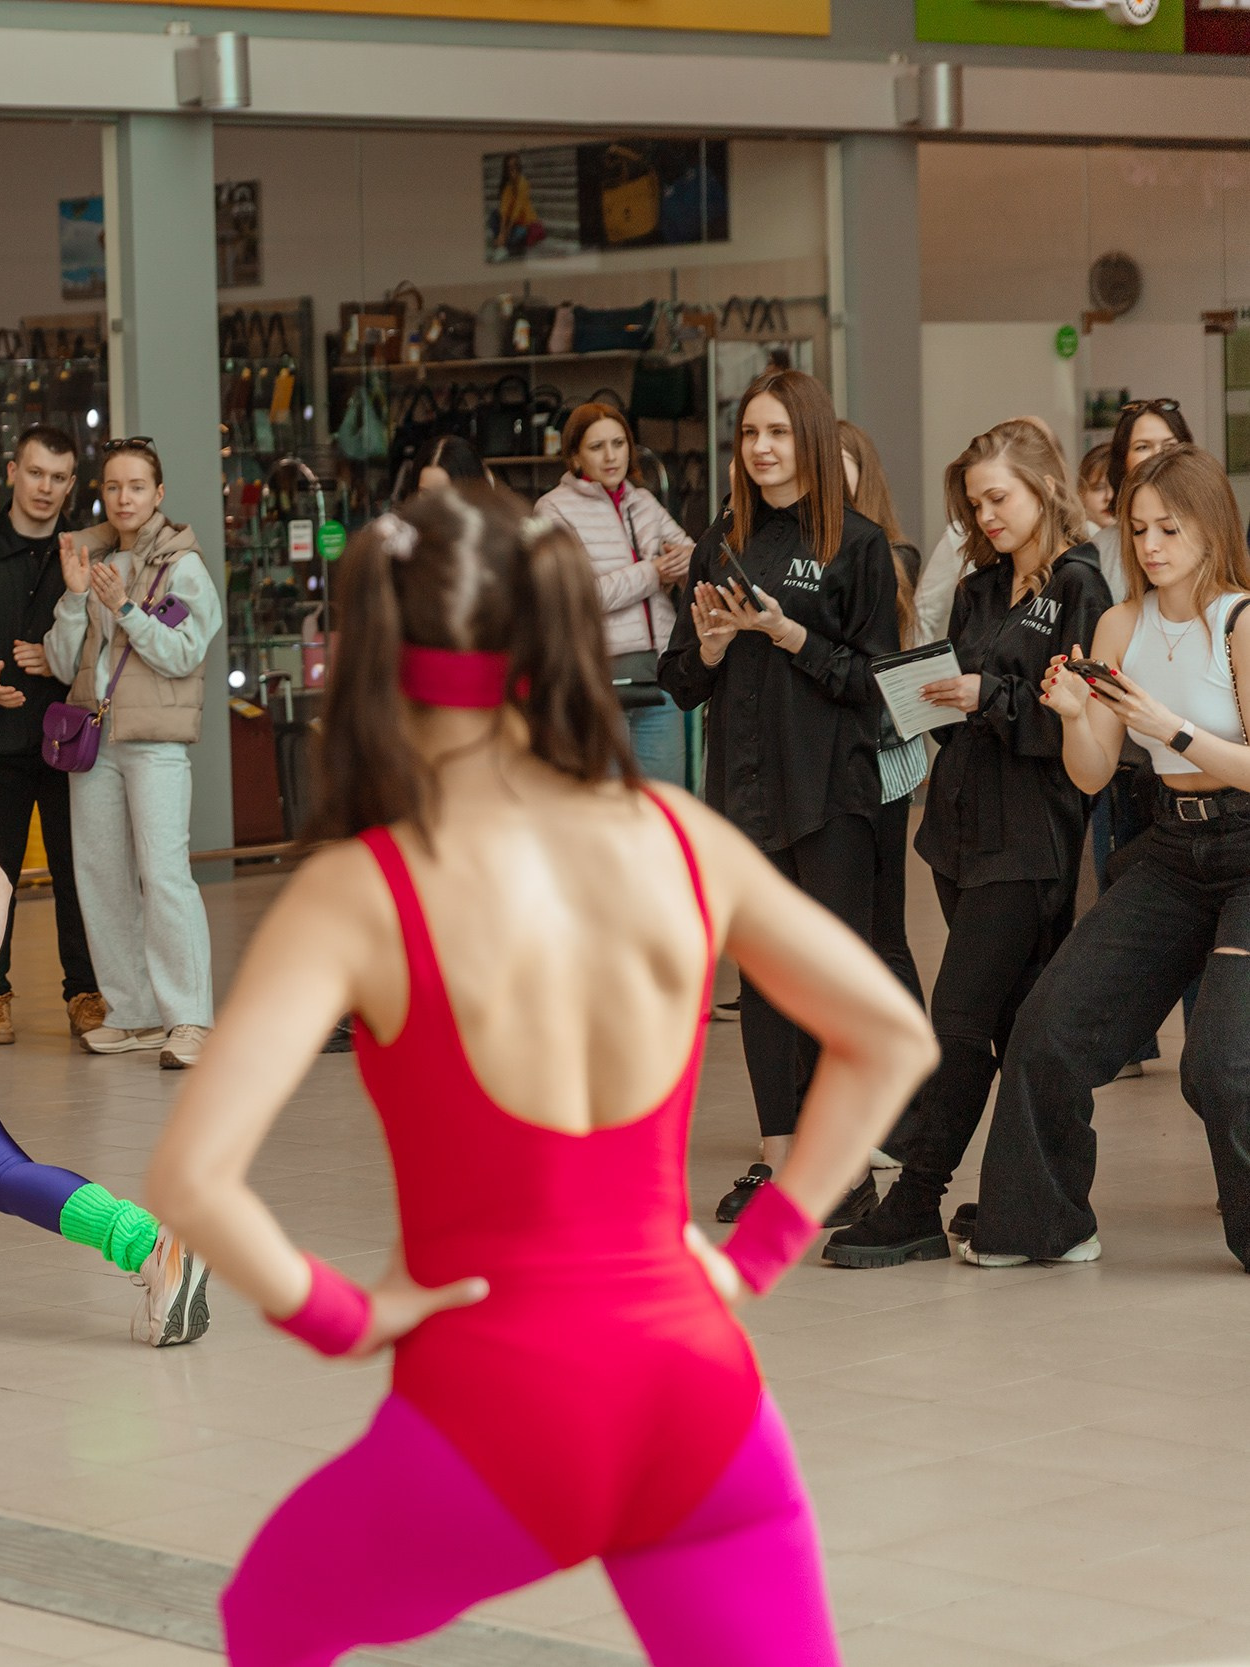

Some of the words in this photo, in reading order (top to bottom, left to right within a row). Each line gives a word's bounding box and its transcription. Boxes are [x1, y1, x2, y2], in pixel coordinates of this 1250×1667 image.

[786, 557, 827, 580] NN
[782, 579, 820, 592] FITNESS
[1026, 596, 1063, 624] NN
